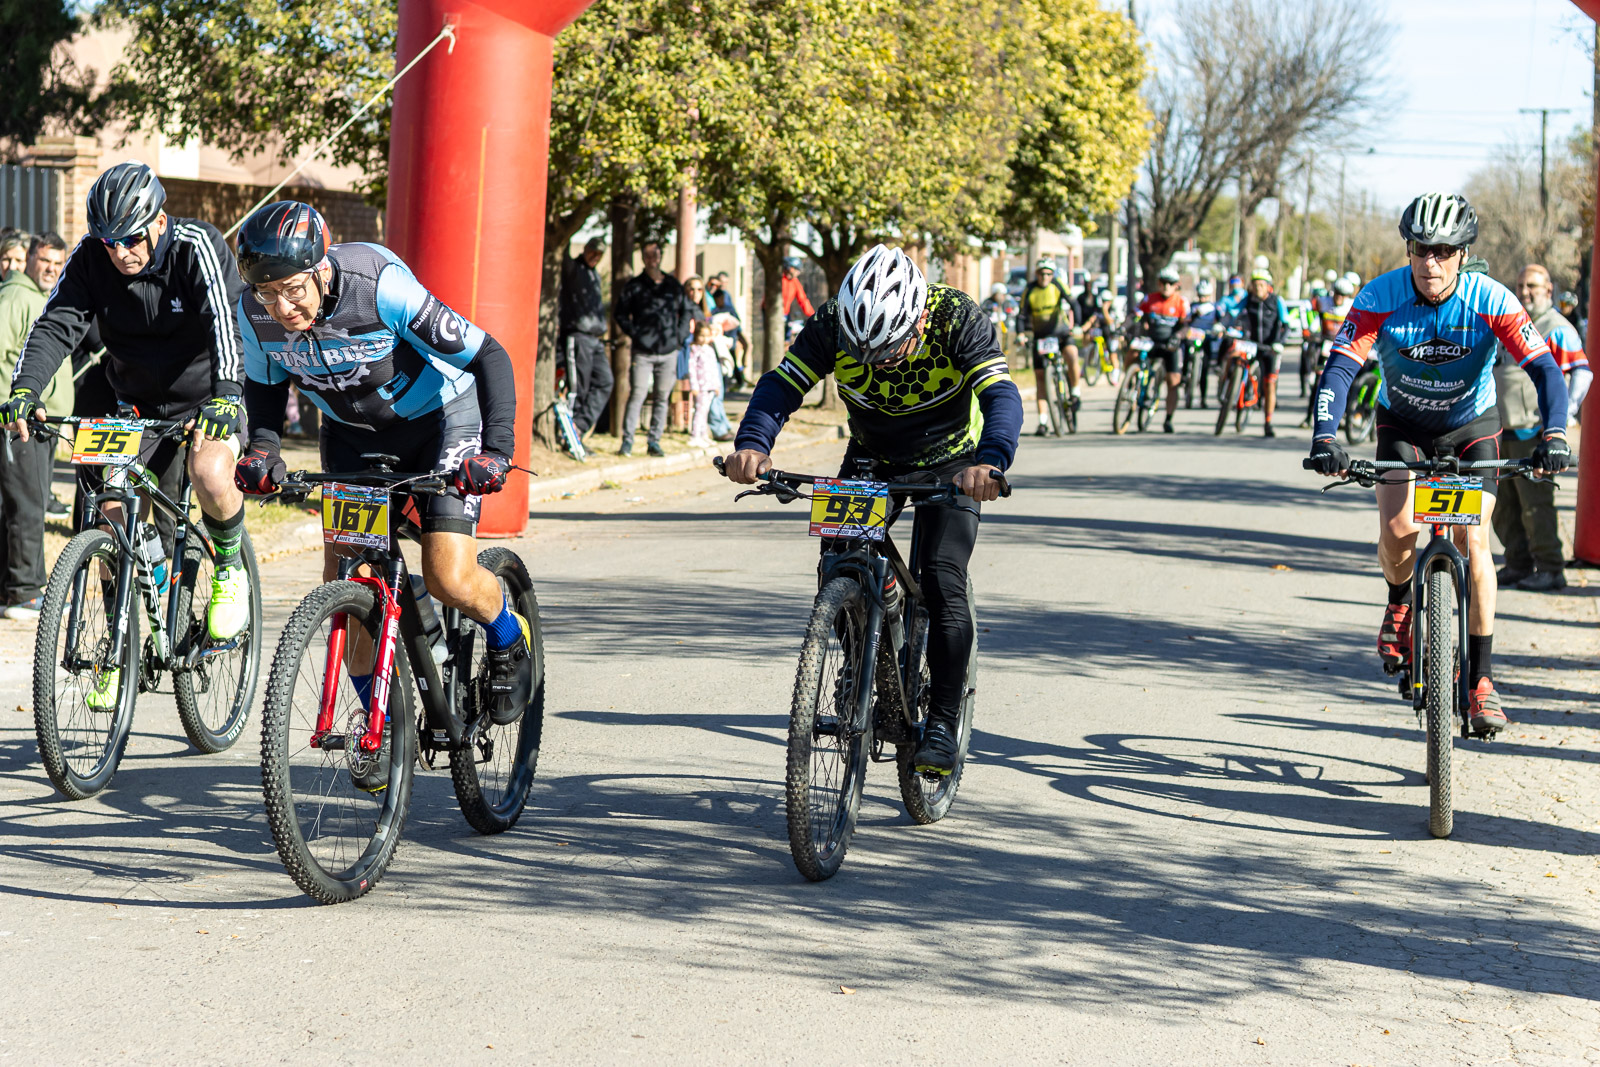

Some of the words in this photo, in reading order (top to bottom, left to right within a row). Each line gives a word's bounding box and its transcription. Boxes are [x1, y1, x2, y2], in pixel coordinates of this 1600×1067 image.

[84, 431, 132, 453] 35
[823, 495, 876, 525] 93
[1428, 490, 1465, 513] 51
[331, 500, 382, 533] 167
